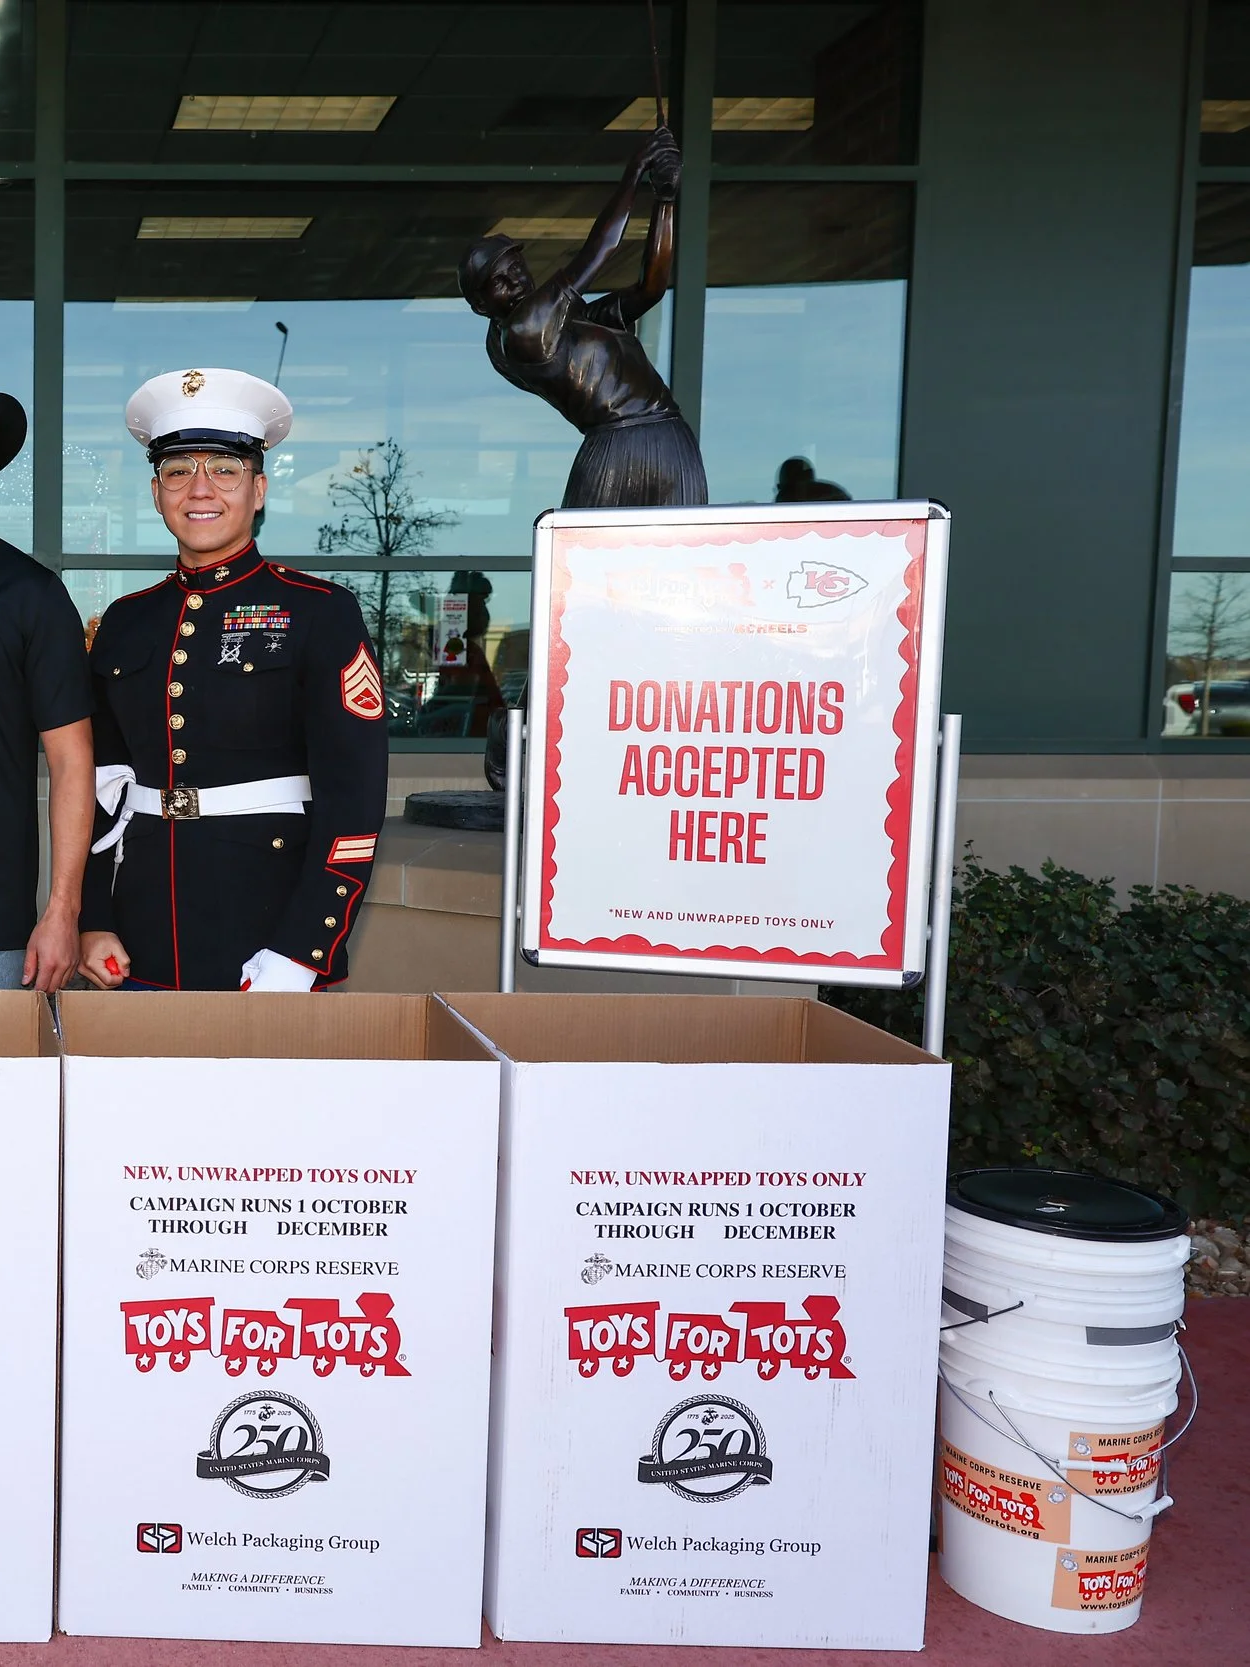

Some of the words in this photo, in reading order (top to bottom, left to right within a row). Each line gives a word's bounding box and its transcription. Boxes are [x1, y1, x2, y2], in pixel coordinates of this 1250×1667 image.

[608, 680, 845, 735] DONATIONS
[619, 744, 825, 800] ACCEPTED
[669, 810, 768, 864] HERE
[647, 911, 673, 920] AND
[678, 913, 760, 925] UNWRAPPED
[765, 917, 796, 927] TOYS
[801, 919, 834, 928] ONLY
[123, 1165, 172, 1181] NEW,
[178, 1166, 303, 1182] UNWRAPPED
[308, 1168, 358, 1184] TOYS
[364, 1169, 417, 1184] ONLY
[570, 1171, 619, 1187] NEW,
[625, 1171, 751, 1186] UNWRAPPED
[756, 1172, 807, 1187] TOYS
[812, 1172, 866, 1187] ONLY
[130, 1196, 235, 1213] CAMPAIGN
[240, 1198, 292, 1213] RUNS
[298, 1200, 306, 1214] 1
[311, 1199, 408, 1214] OCTOBER
[576, 1202, 682, 1217] CAMPAIGN
[688, 1203, 739, 1217] RUNS
[746, 1203, 753, 1216] 1
[759, 1203, 856, 1218] OCTOBER
[148, 1219, 248, 1235] THROUGH
[277, 1221, 388, 1237] DECEMBER
[595, 1225, 694, 1239] THROUGH
[724, 1225, 836, 1240] DECEMBER
[169, 1259, 244, 1274] MARINE
[249, 1260, 310, 1275] CORPS
[315, 1261, 399, 1276] RESERVE
[615, 1264, 691, 1278] MARINE
[695, 1264, 756, 1278] CORPS
[761, 1264, 846, 1278] RESERVE
[129, 1308, 206, 1346] TOYS
[224, 1316, 286, 1353] FOR
[305, 1321, 388, 1358] TOTS
[573, 1313, 650, 1352] TOYS
[668, 1320, 730, 1357] FOR
[750, 1323, 833, 1360] TOTS
[233, 1424, 308, 1457] 250
[674, 1429, 751, 1462] 250
[1099, 1438, 1130, 1446] MARINE
[1134, 1432, 1153, 1444] CORPS
[946, 1446, 967, 1465] MARINE
[970, 1461, 995, 1478] CORPS
[999, 1473, 1041, 1491] RESERVE
[945, 1467, 964, 1489] TOYS
[969, 1483, 990, 1504] FOR
[998, 1498, 1034, 1520] TOTS
[946, 1493, 1039, 1539] www.toysfortots.org
[187, 1532, 237, 1547] Welch
[242, 1533, 324, 1551] Packaging
[328, 1535, 380, 1553] Group
[627, 1536, 677, 1551] Welch
[682, 1537, 766, 1555] Packaging
[769, 1539, 821, 1555] Group
[1082, 1576, 1111, 1590] TOYS
[1117, 1576, 1134, 1587] FOR
